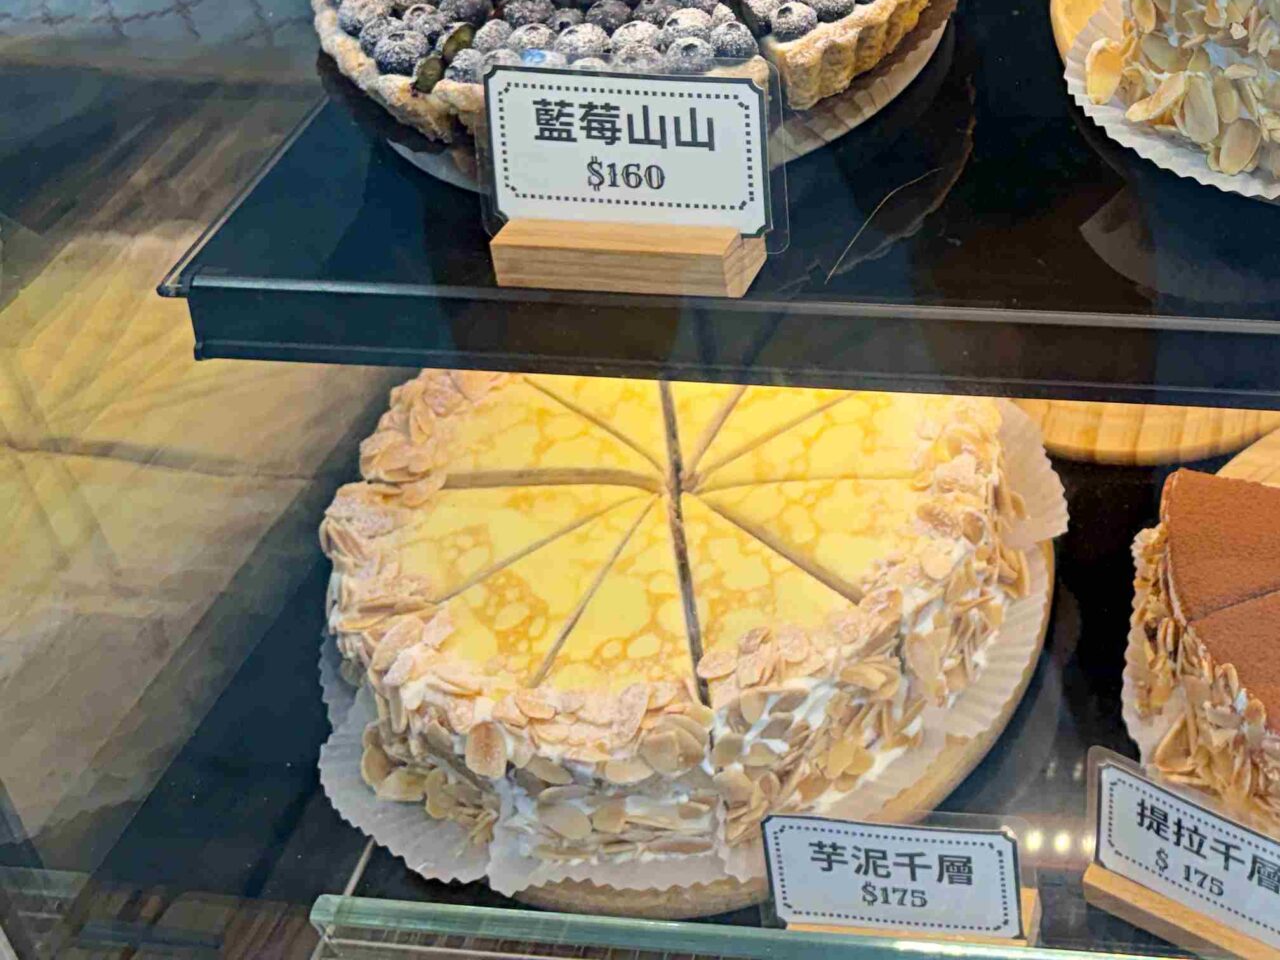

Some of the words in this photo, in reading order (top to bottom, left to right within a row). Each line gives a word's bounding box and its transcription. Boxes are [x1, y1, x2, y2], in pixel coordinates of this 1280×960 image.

[533, 98, 715, 151] 藍莓山山
[587, 156, 665, 191] $160
[808, 840, 973, 886] 芋泥千層
[861, 881, 928, 908] $175
